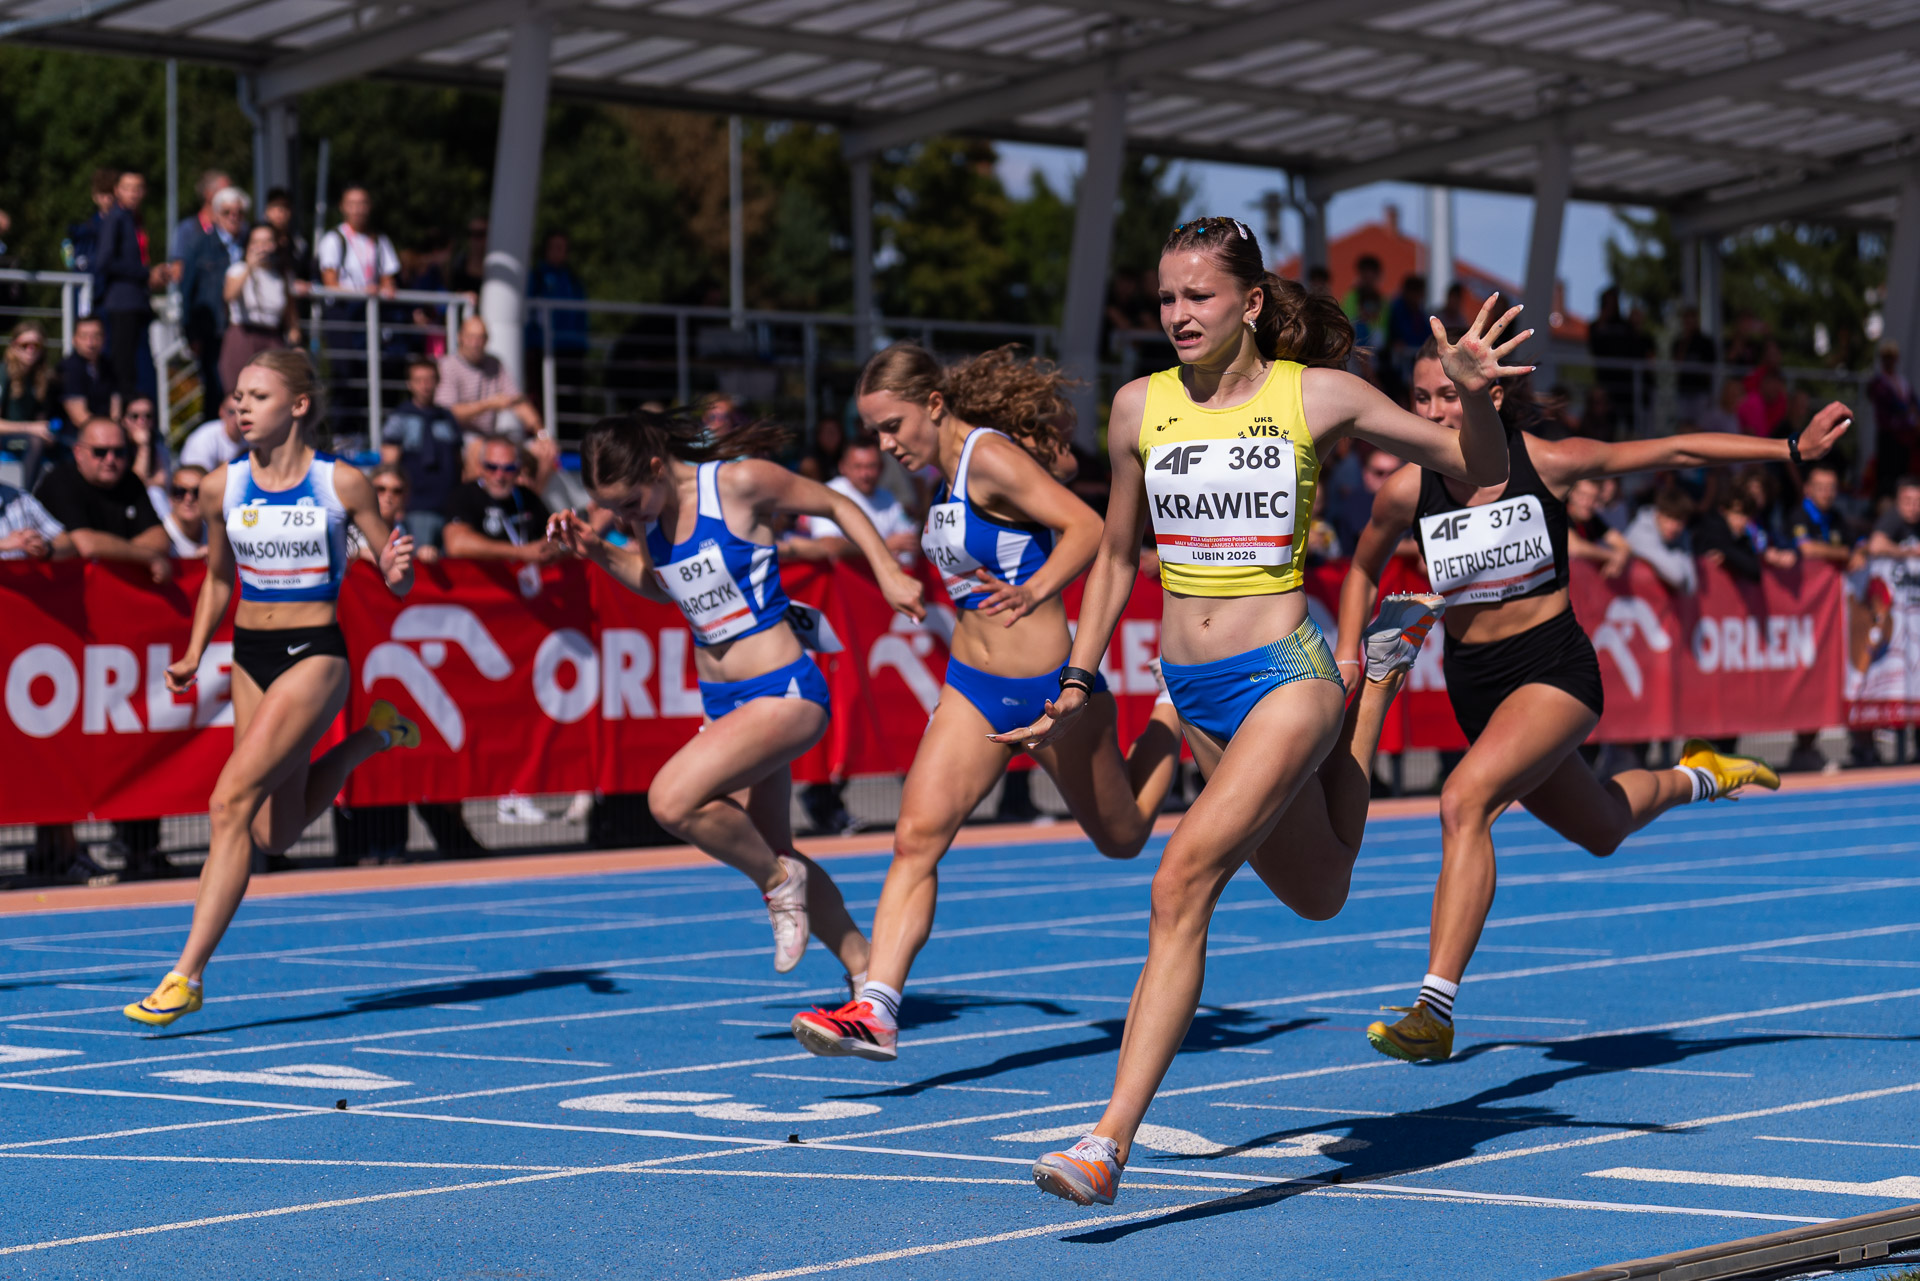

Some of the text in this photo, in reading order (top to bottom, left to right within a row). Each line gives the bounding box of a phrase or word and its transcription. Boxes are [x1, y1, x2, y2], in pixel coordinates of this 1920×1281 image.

[1248, 425, 1279, 437] VIS
[1154, 444, 1209, 475] 4F
[1228, 445, 1281, 470] 368
[1154, 490, 1289, 519] KRAWIEC
[1489, 503, 1532, 529] 373
[281, 511, 316, 526] 785
[1192, 551, 1257, 561] LUBIN 2026
[1433, 535, 1547, 582] PIETRUSZCZAK
[679, 558, 716, 582] 891
[680, 582, 738, 617] ARCZYK
[1470, 591, 1499, 600] LUBIN
[1692, 613, 1817, 674] ORLEN
[532, 628, 704, 723] ORL
[5, 643, 234, 738] ORLE
